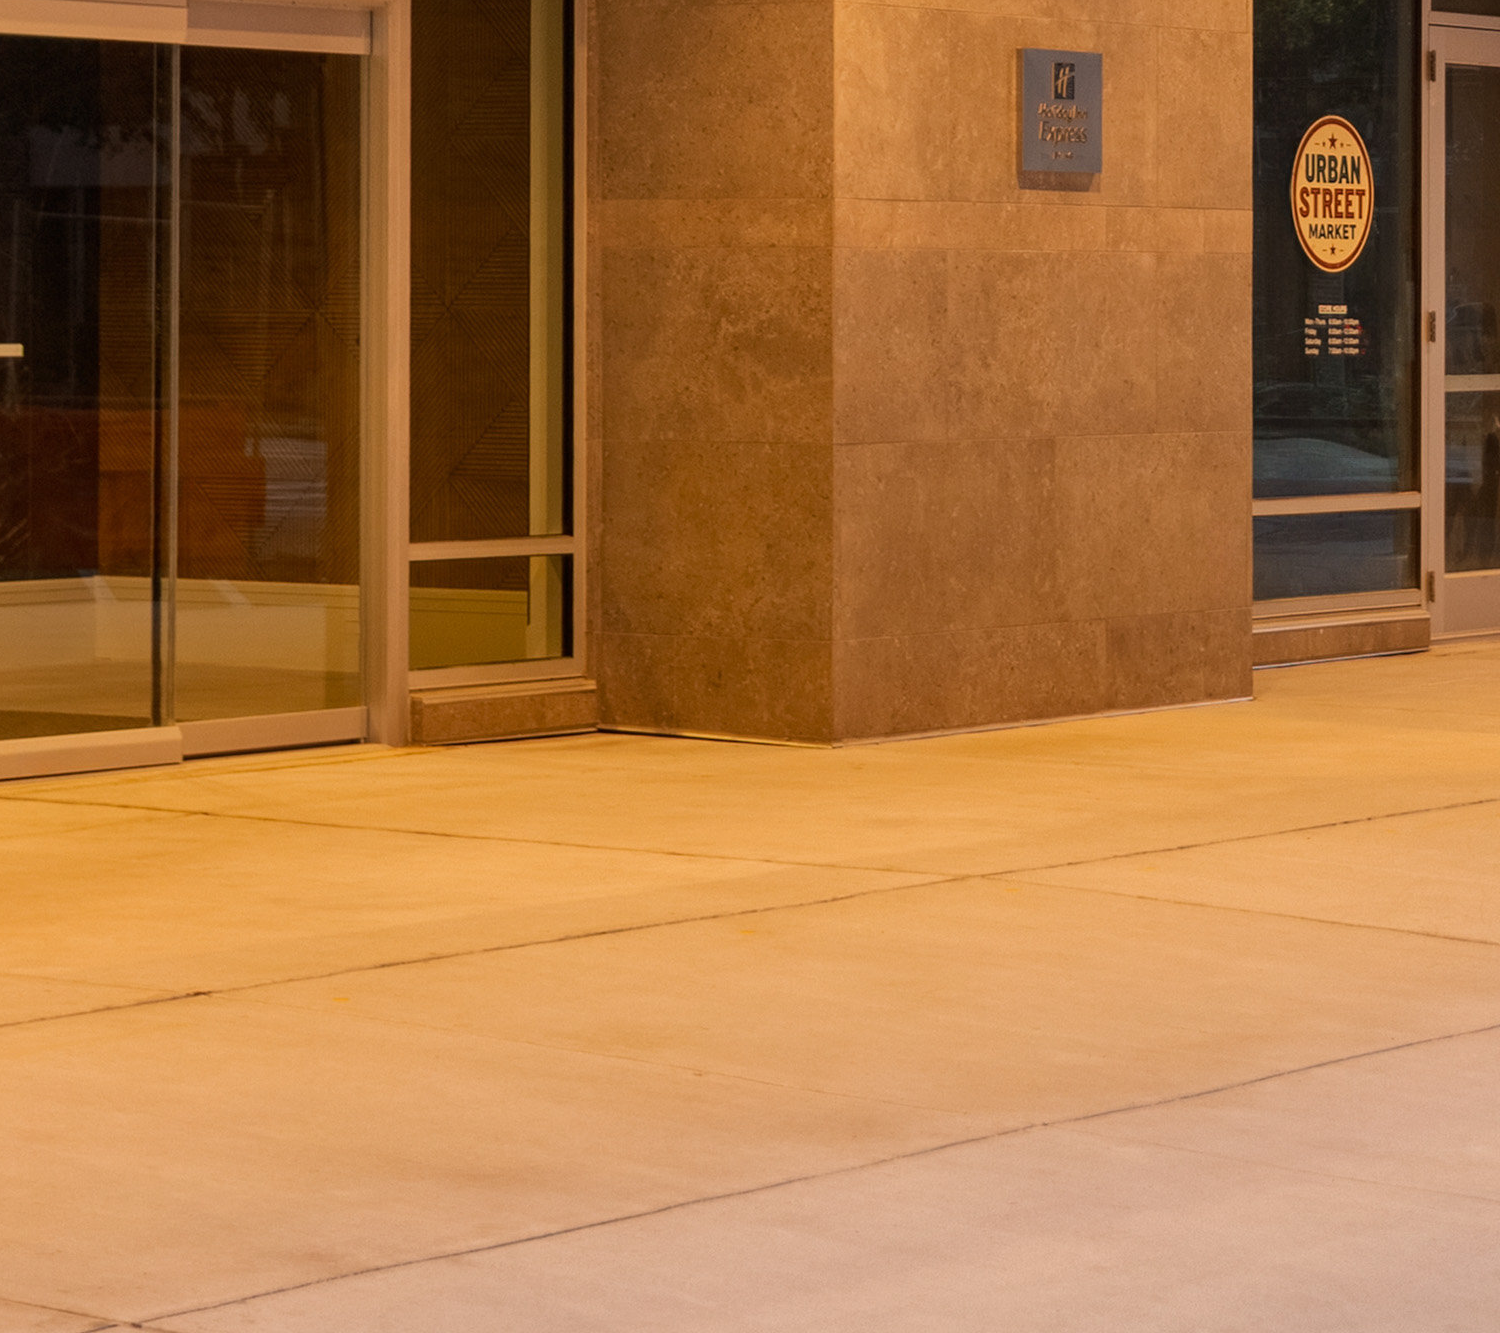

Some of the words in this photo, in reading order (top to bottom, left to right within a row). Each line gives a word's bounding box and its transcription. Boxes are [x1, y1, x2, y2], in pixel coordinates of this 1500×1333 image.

[1305, 153, 1361, 184] URBAN
[1299, 186, 1366, 219] STREET
[1308, 224, 1357, 240] MARKET
